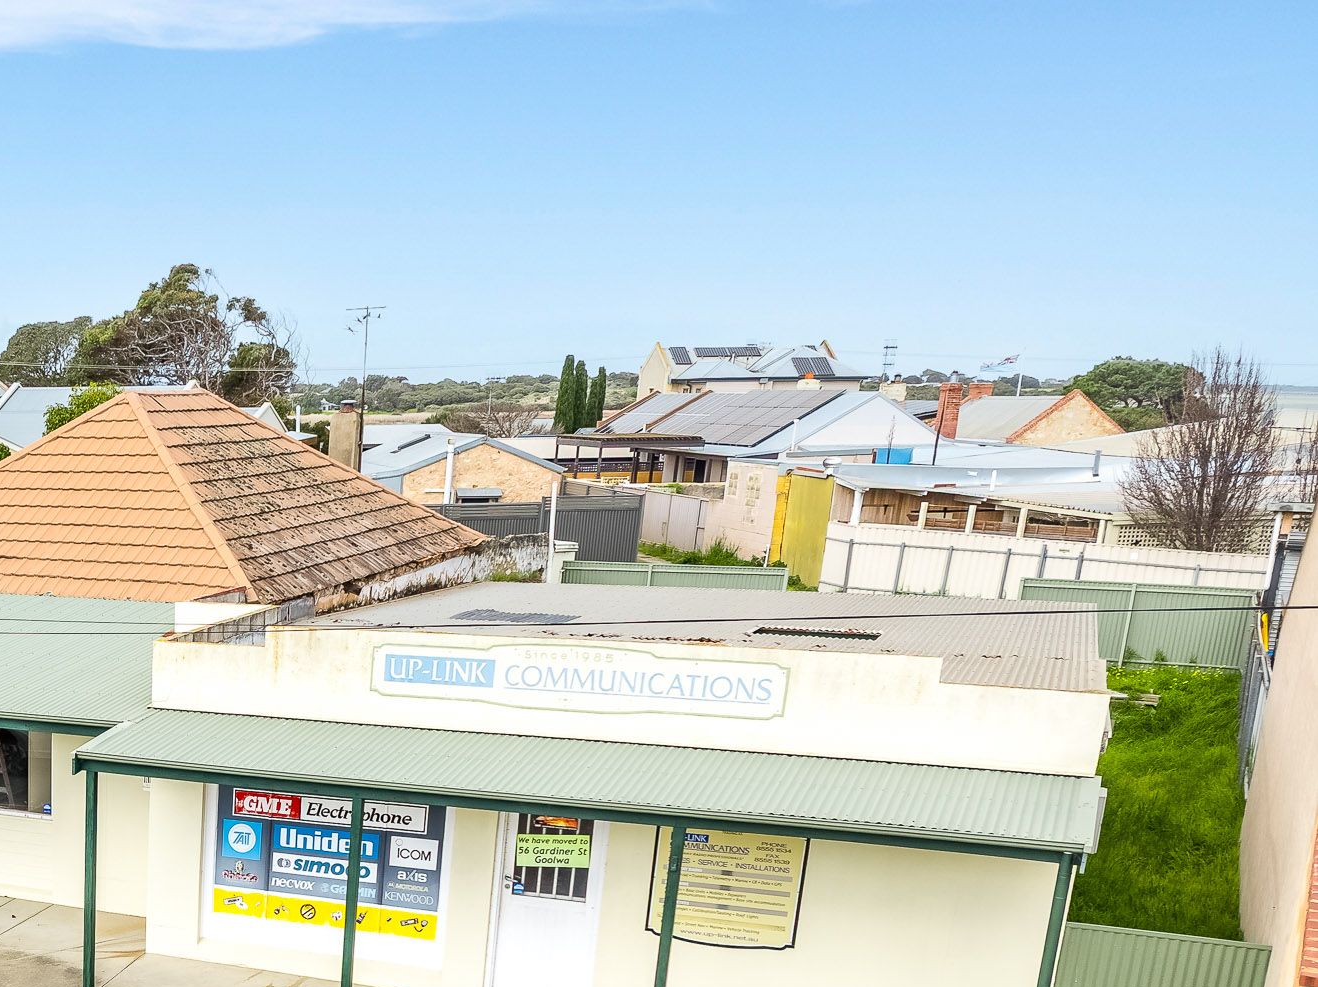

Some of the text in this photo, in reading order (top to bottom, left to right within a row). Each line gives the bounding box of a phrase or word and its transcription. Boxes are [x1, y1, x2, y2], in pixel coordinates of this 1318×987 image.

[524, 649, 614, 664] Since 1985
[389, 657, 773, 702] UP-LINK COMMUNICATIONS
[244, 795, 413, 826] GME Electrphone
[279, 827, 374, 856] Uniden
[532, 837, 551, 845] have
[552, 837, 578, 845] moved
[579, 838, 589, 846] to
[518, 846, 588, 856] 56 Gardiner St
[534, 855, 570, 864] Goolwa
[697, 858, 729, 868] SERVICE
[735, 862, 791, 874] INSTALLATIONS
[397, 870, 428, 883] axis
[270, 877, 377, 899] necvox GAMIN
[384, 891, 434, 905] KENWOOD
